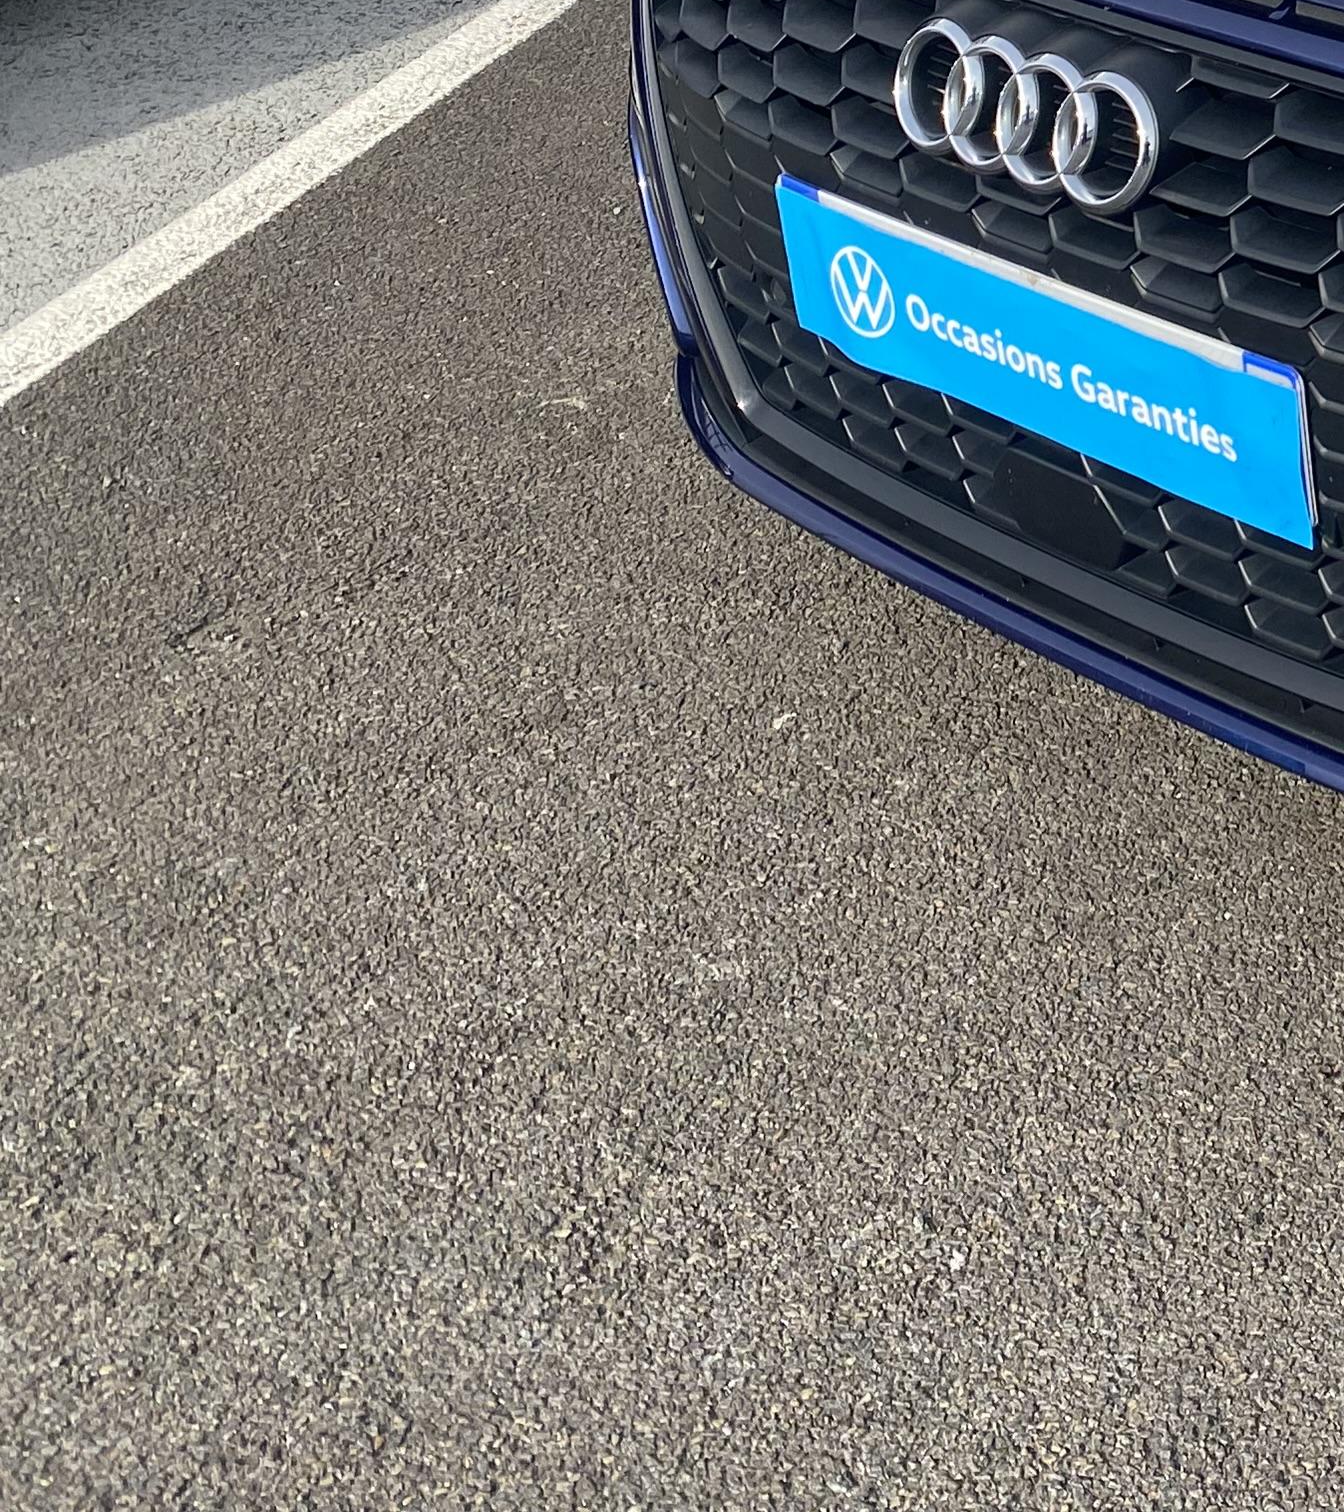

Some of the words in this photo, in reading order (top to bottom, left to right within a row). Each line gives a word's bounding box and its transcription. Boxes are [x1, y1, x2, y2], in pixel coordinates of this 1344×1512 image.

[830, 245, 896, 339] VW
[905, 293, 1063, 391] Occasions
[1071, 364, 1238, 463] Garanties
